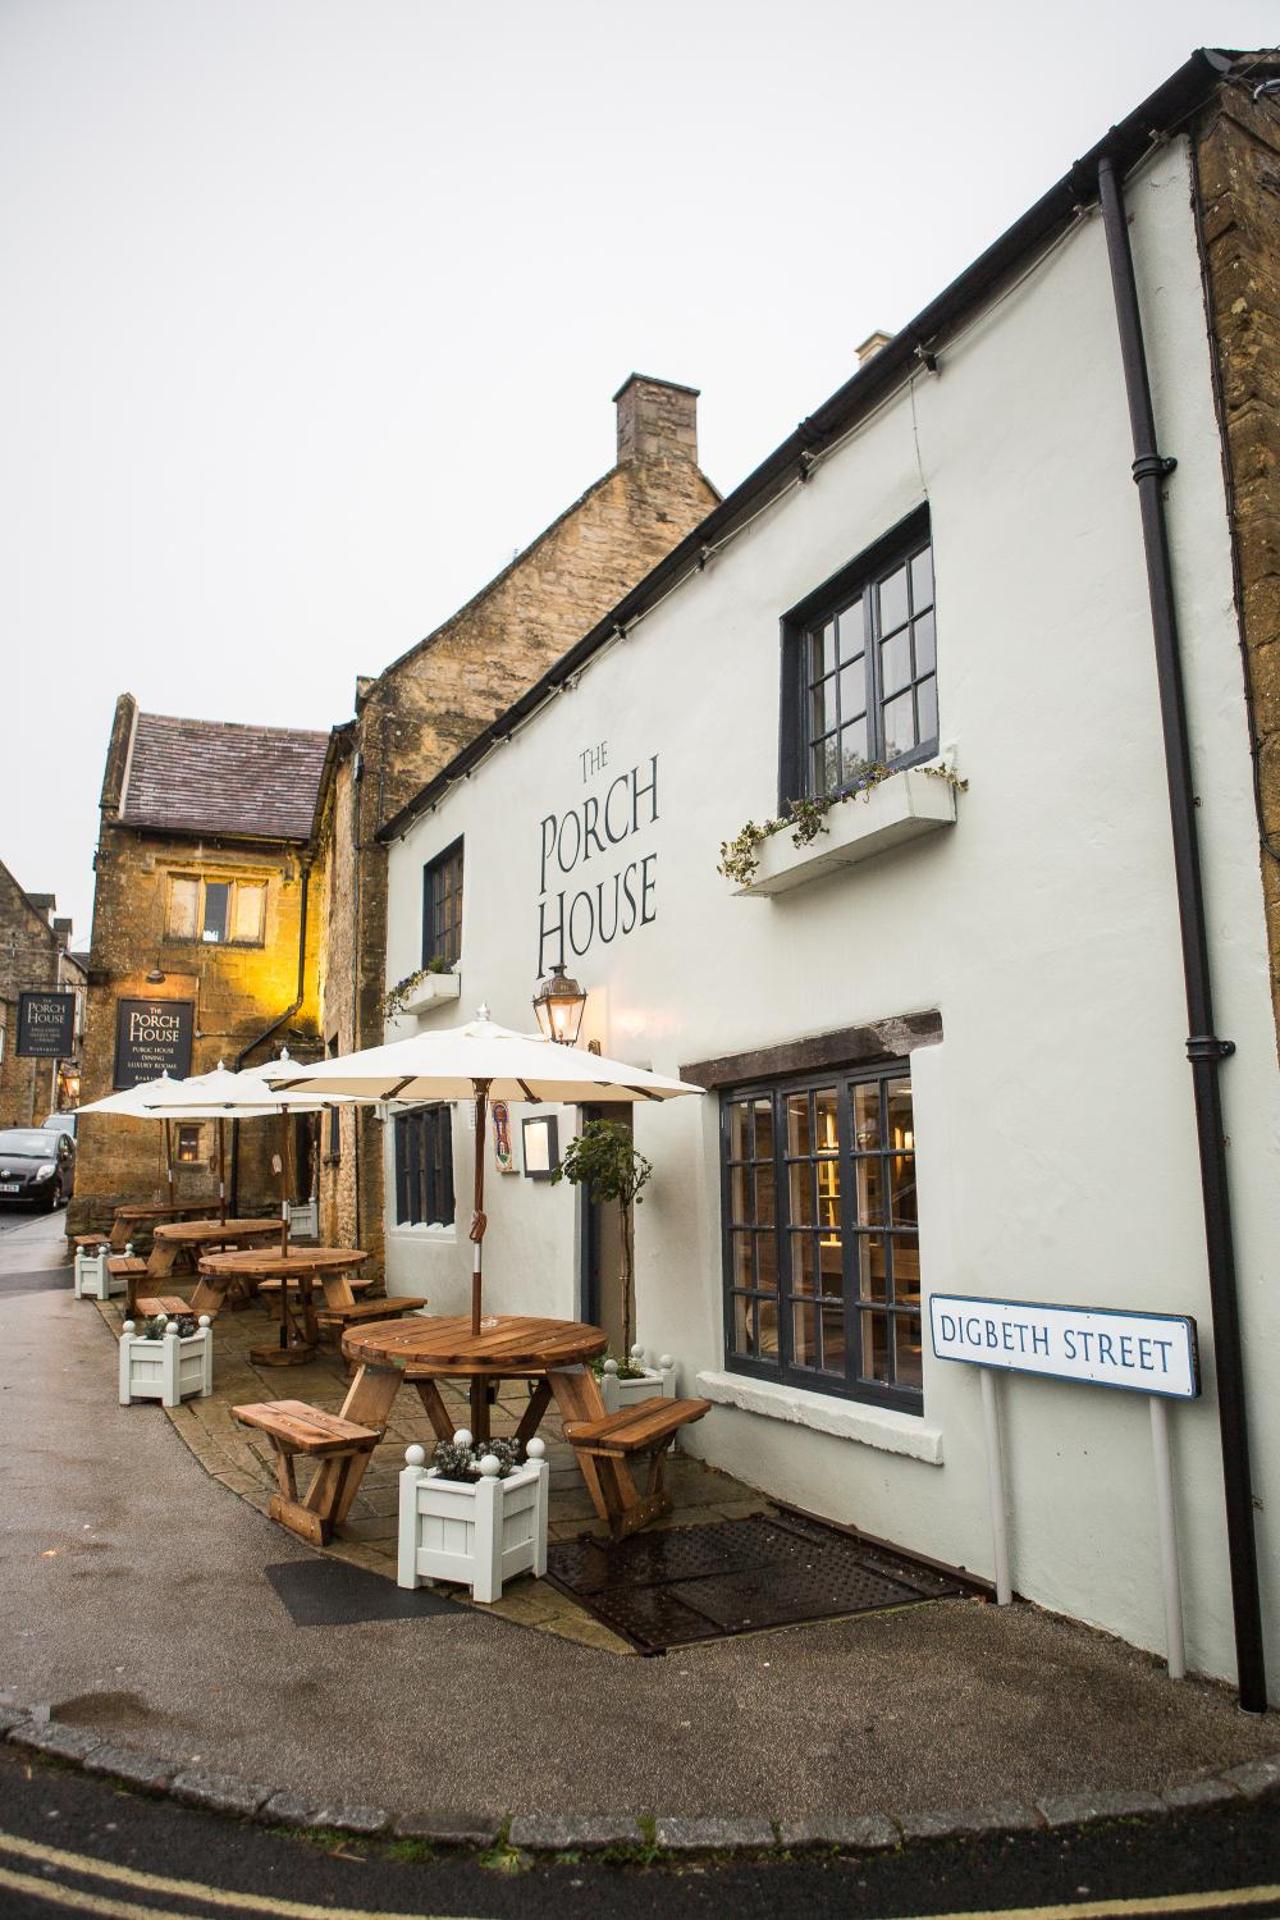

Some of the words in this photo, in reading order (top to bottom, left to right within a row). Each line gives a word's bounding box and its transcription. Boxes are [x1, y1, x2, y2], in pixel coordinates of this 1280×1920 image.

[579, 741, 608, 784] THE
[539, 753, 660, 896] PORCH
[536, 852, 658, 980] HOUSE
[28, 1002, 65, 1014] PORCH
[28, 1013, 64, 1024] HOUSE
[130, 1012, 180, 1029] PORCH
[129, 1027, 180, 1042] HOUSE
[132, 1046, 153, 1054] PUBLIC
[141, 1054, 165, 1062] DINING
[940, 1315, 1050, 1356] DIGBETH
[1063, 1329, 1173, 1373] STREET
